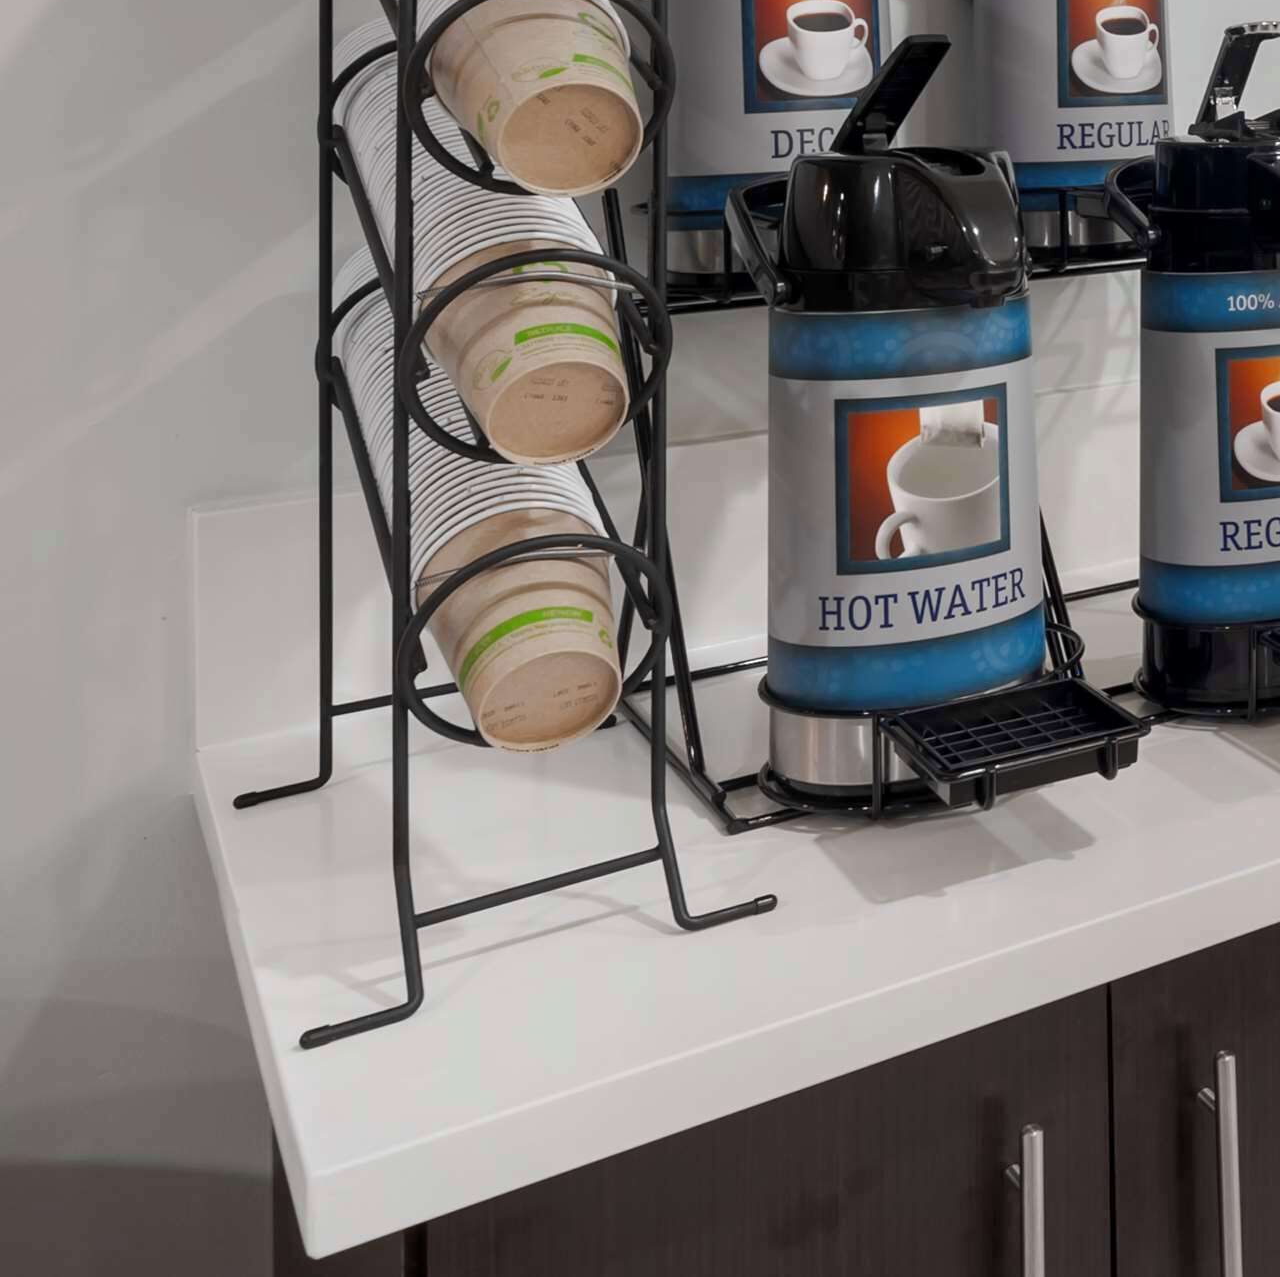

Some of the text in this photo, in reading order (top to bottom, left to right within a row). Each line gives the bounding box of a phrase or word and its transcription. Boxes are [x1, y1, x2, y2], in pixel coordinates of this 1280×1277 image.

[770, 127, 835, 159] DEC
[1056, 120, 1170, 150] REGULAR
[1227, 293, 1275, 311] 100%
[818, 567, 1026, 631] HOT WATER
